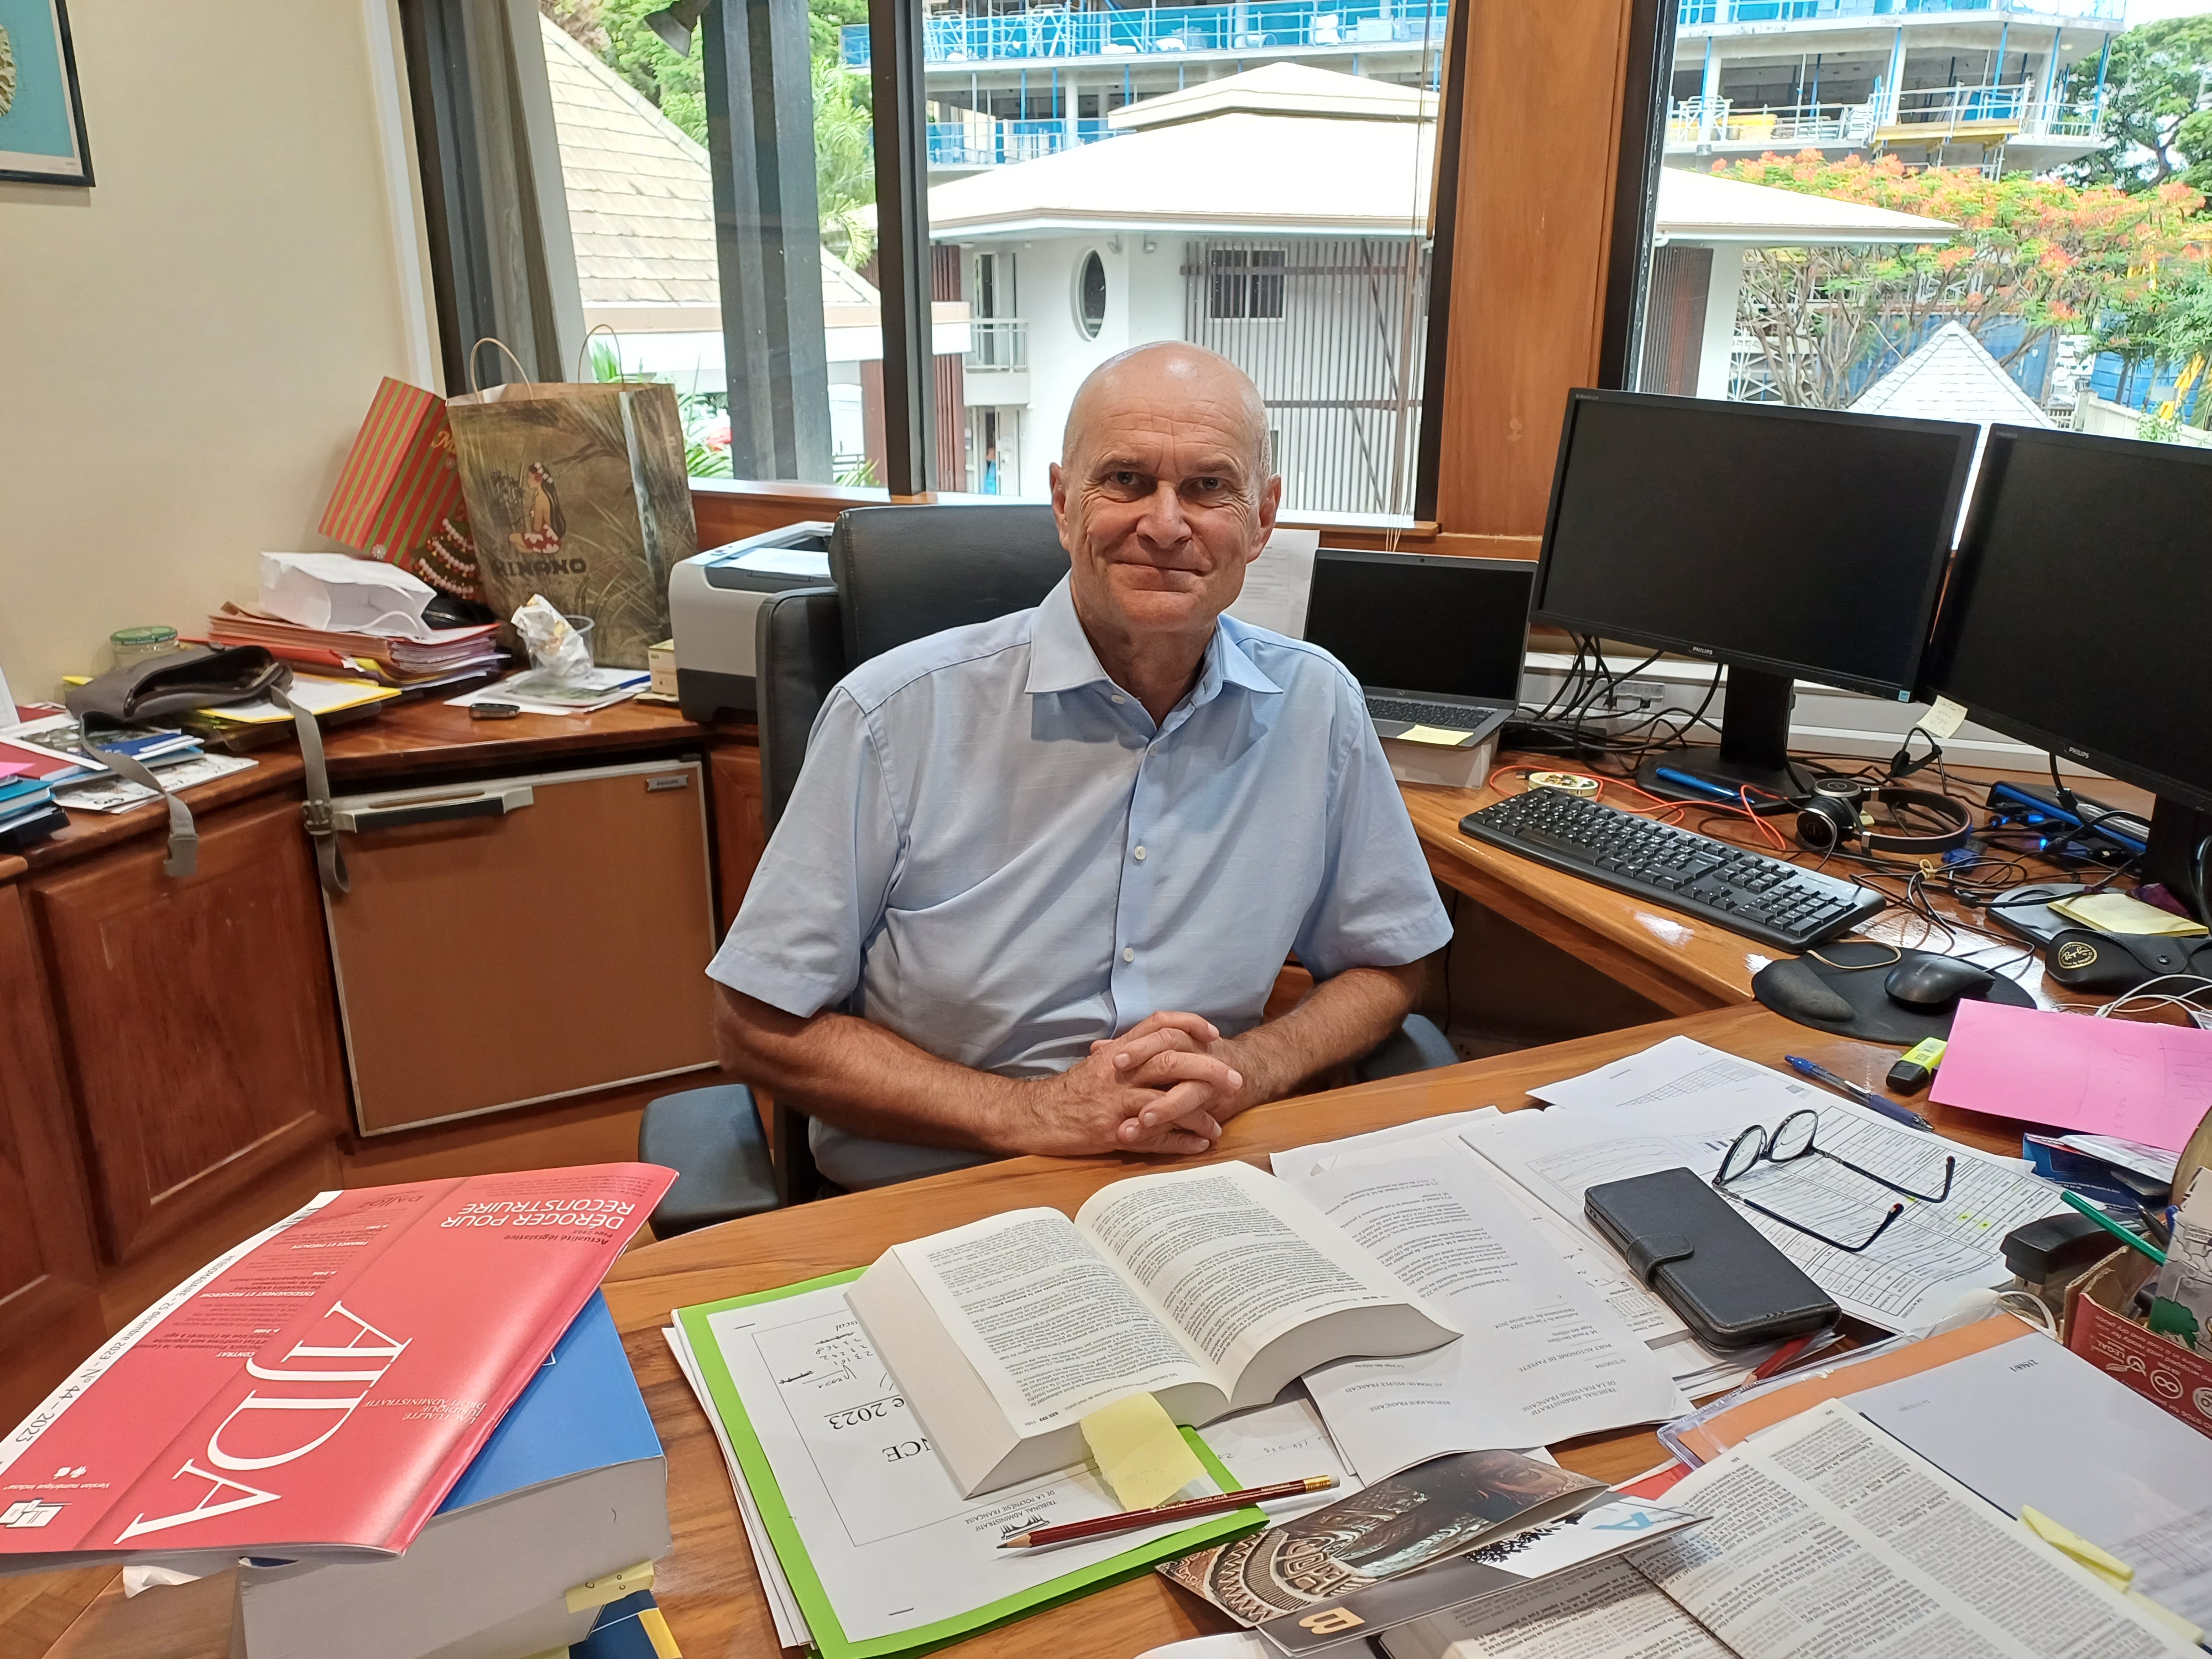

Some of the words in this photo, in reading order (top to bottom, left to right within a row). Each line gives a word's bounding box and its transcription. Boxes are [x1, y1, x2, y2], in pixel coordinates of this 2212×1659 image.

[1693, 646, 1713, 655] PHILIPS
[2069, 747, 2090, 759] PHILIPS
[440, 1215, 507, 1227] POUR
[513, 1213, 625, 1230] DÉROGER
[560, 1235, 609, 1245] Actualité
[175, 1255, 236, 1297] HEBDOMADAIRE
[158, 1302, 174, 1311] 25
[121, 1311, 160, 1342] décembre
[2095, 1315, 2116, 1327] place
[1572, 1331, 1589, 1340] Pascal
[2110, 1331, 2122, 1340] for
[2117, 1325, 2130, 1335] dry
[1547, 1335, 1572, 1344] Devillers
[2122, 1335, 2145, 1350] ready
[2130, 1333, 2146, 1344] and
[99, 1342, 125, 1360] 2023
[2097, 1340, 2125, 1358] LEGAL
[2147, 1340, 2164, 1353] cool
[1556, 1347, 1593, 1364] AUTONOME
[2164, 1357, 2200, 1377] wrapped
[2182, 1358, 2203, 1371] Store
[59, 1385, 80, 1400] 44
[1345, 1383, 1380, 1394] FRANÇAIS
[1582, 1387, 1617, 1399] TRIBUNAL
[361, 1398, 449, 1407] ADMINISTRATIF
[1368, 1401, 1408, 1412] FRANÇAISE
[1531, 1394, 1582, 1416] ADMINISTRATIF
[113, 1300, 412, 1545] AJDA
[829, 1402, 887, 1430] 2023
[15, 1413, 54, 1443] 2023
[1001, 1497, 1035, 1512] POLYNÉSIE
[1024, 1499, 1057, 1514] TRIBUNAL
[964, 1509, 1001, 1525] FRANÇAISE
[975, 1510, 1023, 1532] ADMINISTRATIF
[1590, 1512, 1653, 1531] A
[1298, 1606, 1365, 1635] B
